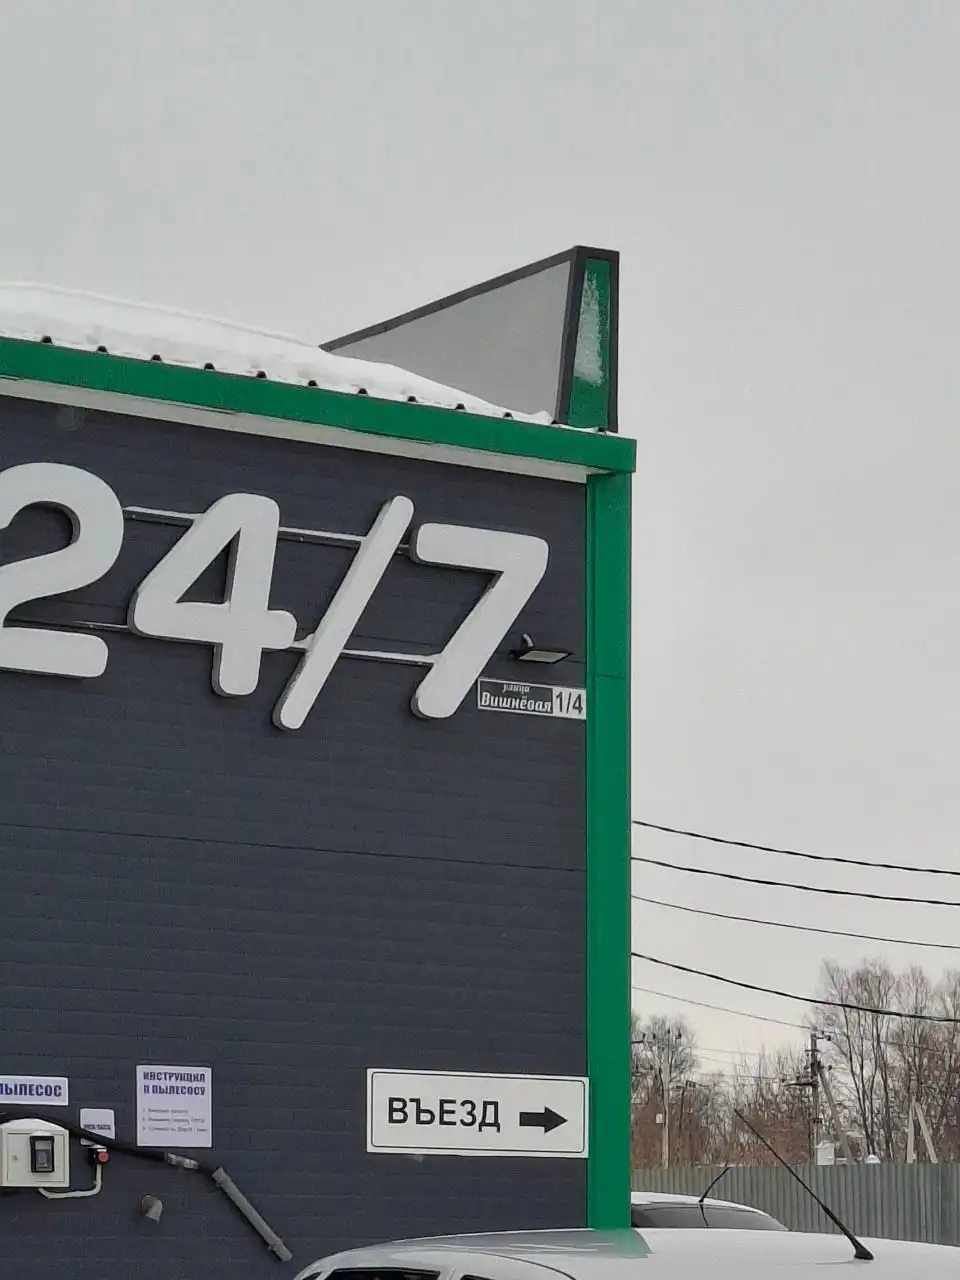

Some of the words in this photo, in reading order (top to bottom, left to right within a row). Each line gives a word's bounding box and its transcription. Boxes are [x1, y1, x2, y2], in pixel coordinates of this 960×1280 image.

[0, 462, 549, 730] 24/7
[481, 691, 552, 713] Вишнёвая
[555, 691, 584, 714] 1/4
[502, 683, 531, 694] улица
[388, 1097, 500, 1133] ВЪЕЗД
